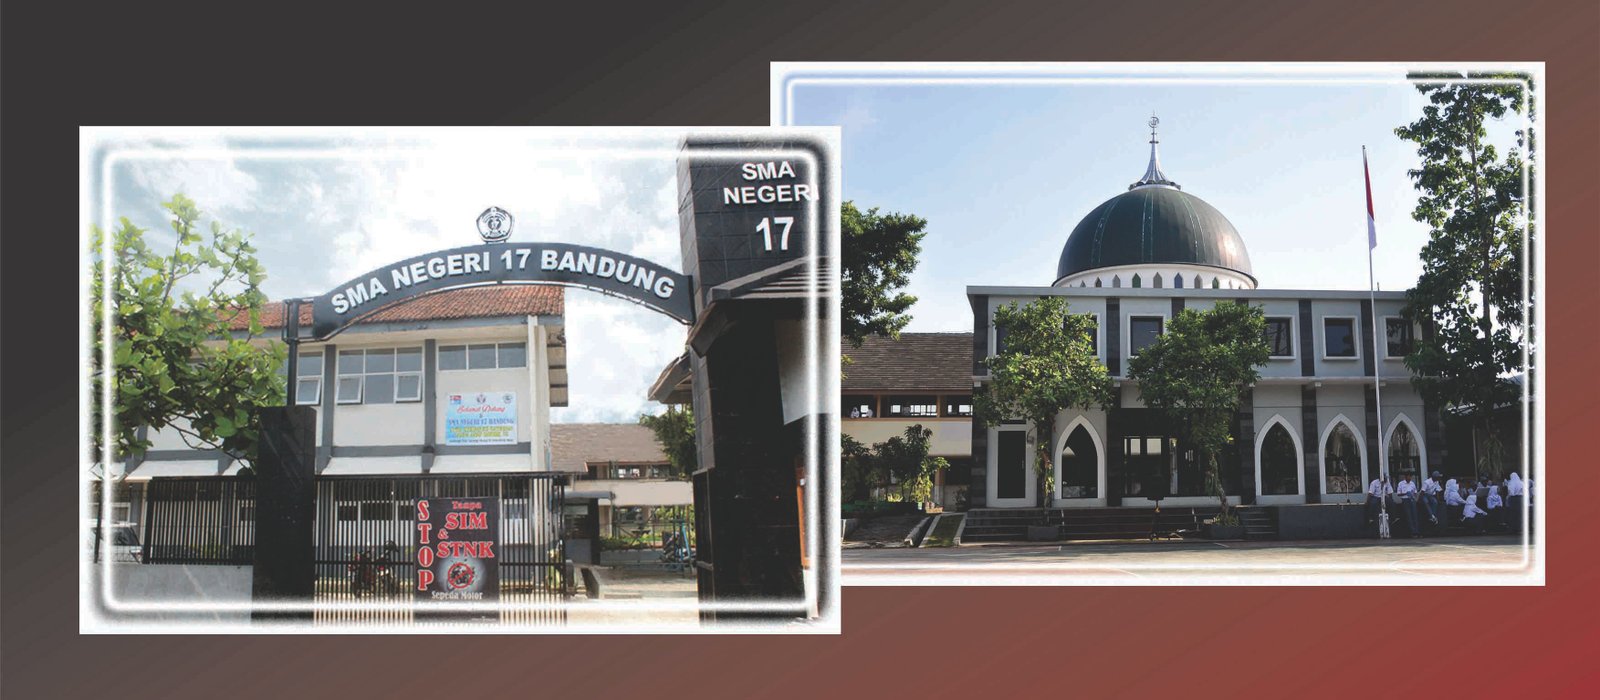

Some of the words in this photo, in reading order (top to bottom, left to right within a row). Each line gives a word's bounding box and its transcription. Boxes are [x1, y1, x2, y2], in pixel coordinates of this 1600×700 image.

[742, 160, 796, 181] SMA
[755, 216, 794, 251] 17
[331, 278, 389, 315] SMA
[392, 252, 491, 289] NEGERI
[500, 248, 531, 270] 17
[540, 249, 675, 300] BANDUNG
[452, 501, 482, 510] Tanpa
[445, 512, 488, 529] SIM
[438, 529, 448, 539] &
[418, 500, 434, 591] STOP
[436, 541, 494, 558] STNK
[431, 590, 459, 600] Sepeda
[461, 591, 483, 600] Motor
